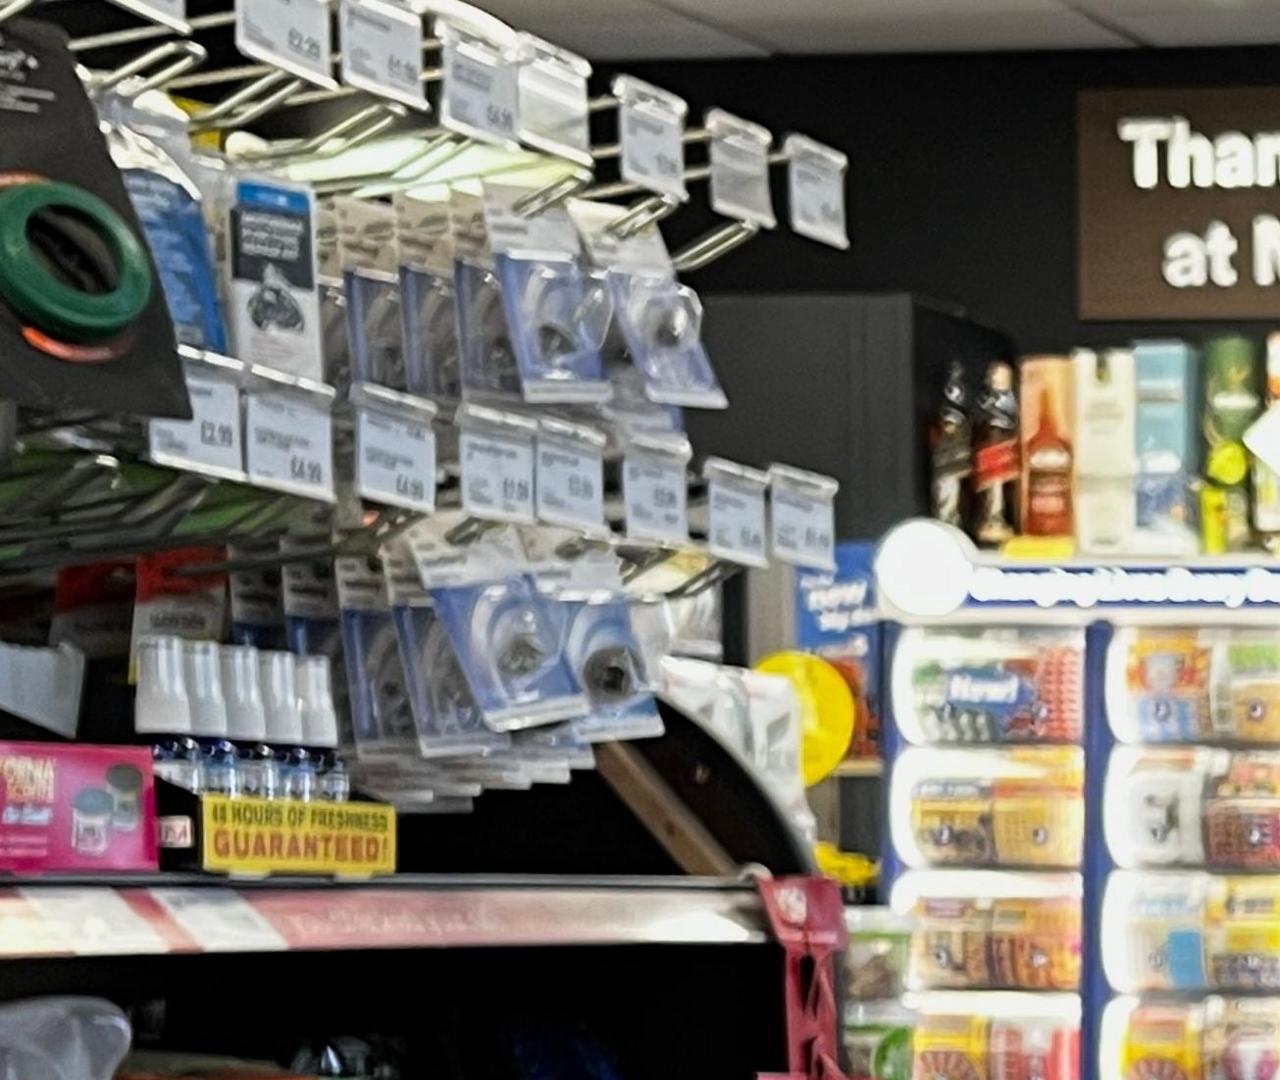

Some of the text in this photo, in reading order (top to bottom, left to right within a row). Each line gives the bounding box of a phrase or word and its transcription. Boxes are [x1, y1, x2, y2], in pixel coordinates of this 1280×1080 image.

[1162, 223, 1237, 288] at
[232, 804, 282, 827] HOURS
[288, 807, 305, 827] OF
[311, 808, 388, 832] FRESHNESS
[214, 828, 388, 863] GUARANTEED!
